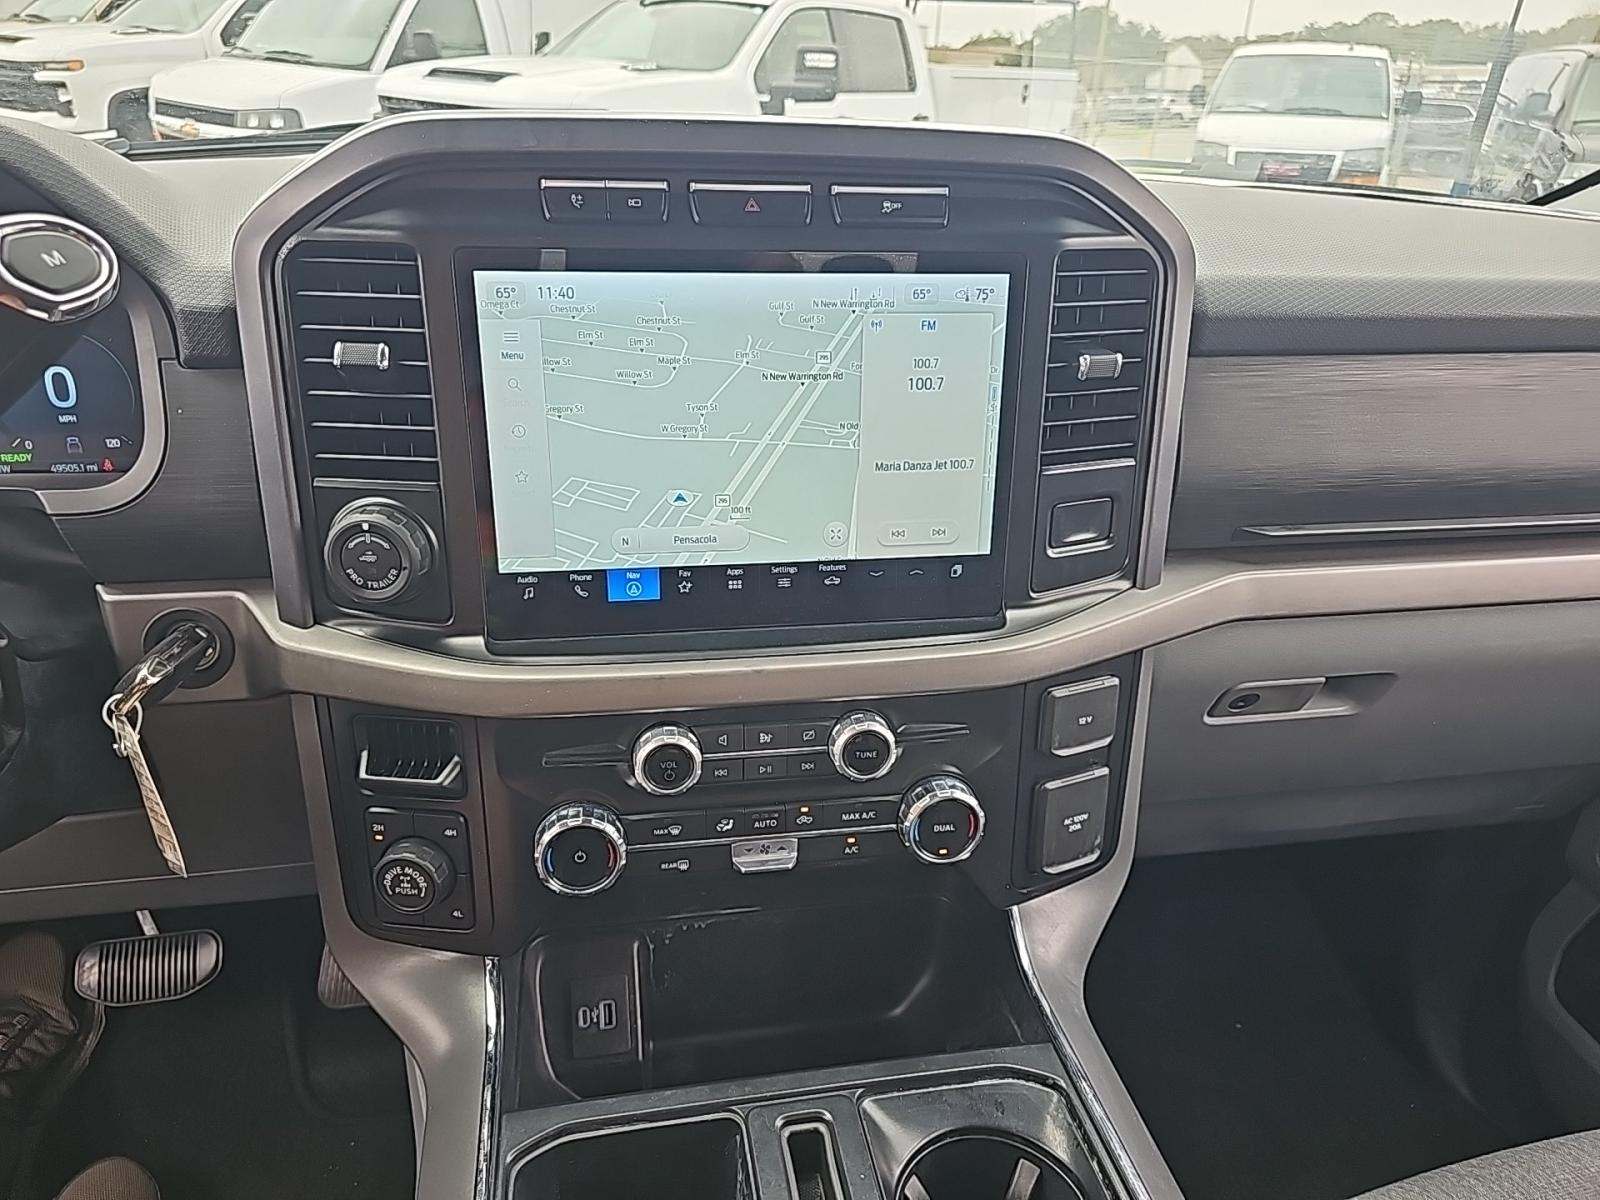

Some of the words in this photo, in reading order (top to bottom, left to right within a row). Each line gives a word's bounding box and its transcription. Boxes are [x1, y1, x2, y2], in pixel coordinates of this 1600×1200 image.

[40, 250, 66, 268] M
[495, 286, 516, 299] 65°
[537, 286, 575, 300] 11:40
[912, 288, 932, 300] 65°
[976, 288, 995, 300] 75°
[480, 301, 510, 310] Omega
[550, 304, 586, 312] Chestnut
[586, 304, 596, 312] St
[769, 302, 784, 310] Gulf
[784, 302, 794, 310] St
[840, 300, 882, 309] Warrington
[636, 316, 669, 324] Chestnut
[671, 316, 680, 324] St
[800, 316, 814, 324] Gulf
[816, 316, 824, 324] St
[921, 320, 936, 331] FM
[578, 331, 592, 339] Elm
[594, 330, 603, 339] St
[629, 338, 643, 346] Elm
[644, 338, 654, 346] St
[501, 352, 524, 360] Menu
[736, 350, 750, 358] Elm
[751, 350, 760, 358] St
[562, 358, 572, 366] St
[658, 357, 680, 366] Maple
[682, 356, 690, 364] St
[913, 358, 939, 369] 100.7
[616, 370, 642, 378] Willow
[644, 370, 652, 378] St
[788, 373, 832, 382] Warrington
[833, 372, 844, 380] Rd
[44, 366, 78, 408] 0
[908, 378, 944, 390] 100.7
[574, 404, 584, 412] St
[687, 404, 709, 412] Tyson
[710, 404, 718, 412] St
[58, 414, 77, 424] MPH
[670, 424, 698, 434] Gregory
[700, 424, 708, 432] St
[24, 440, 34, 450] 0
[104, 438, 120, 448] 120
[0, 453, 32, 462] READY
[50, 464, 85, 472] 49505.1
[86, 464, 98, 472] mi
[875, 462, 901, 472] Maria
[902, 461, 932, 472] Danza
[934, 460, 948, 470] Jet
[950, 460, 974, 470] 100.7
[622, 538, 630, 546] N
[674, 535, 717, 545] Pensacola
[726, 568, 744, 576] Apps
[771, 565, 798, 574] Settings
[818, 564, 846, 572] Features
[346, 568, 364, 586] PRO
[366, 568, 398, 589] TRAILER
[570, 574, 592, 582] Phone
[678, 570, 692, 578] Fav
[517, 576, 538, 584] Audio
[856, 750, 878, 759] TUNE
[842, 812, 860, 820] MAX
[862, 812, 876, 820] A/C
[754, 820, 778, 828] AUTO
[934, 824, 956, 832] DUAL
[384, 866, 402, 886] DRIVE
